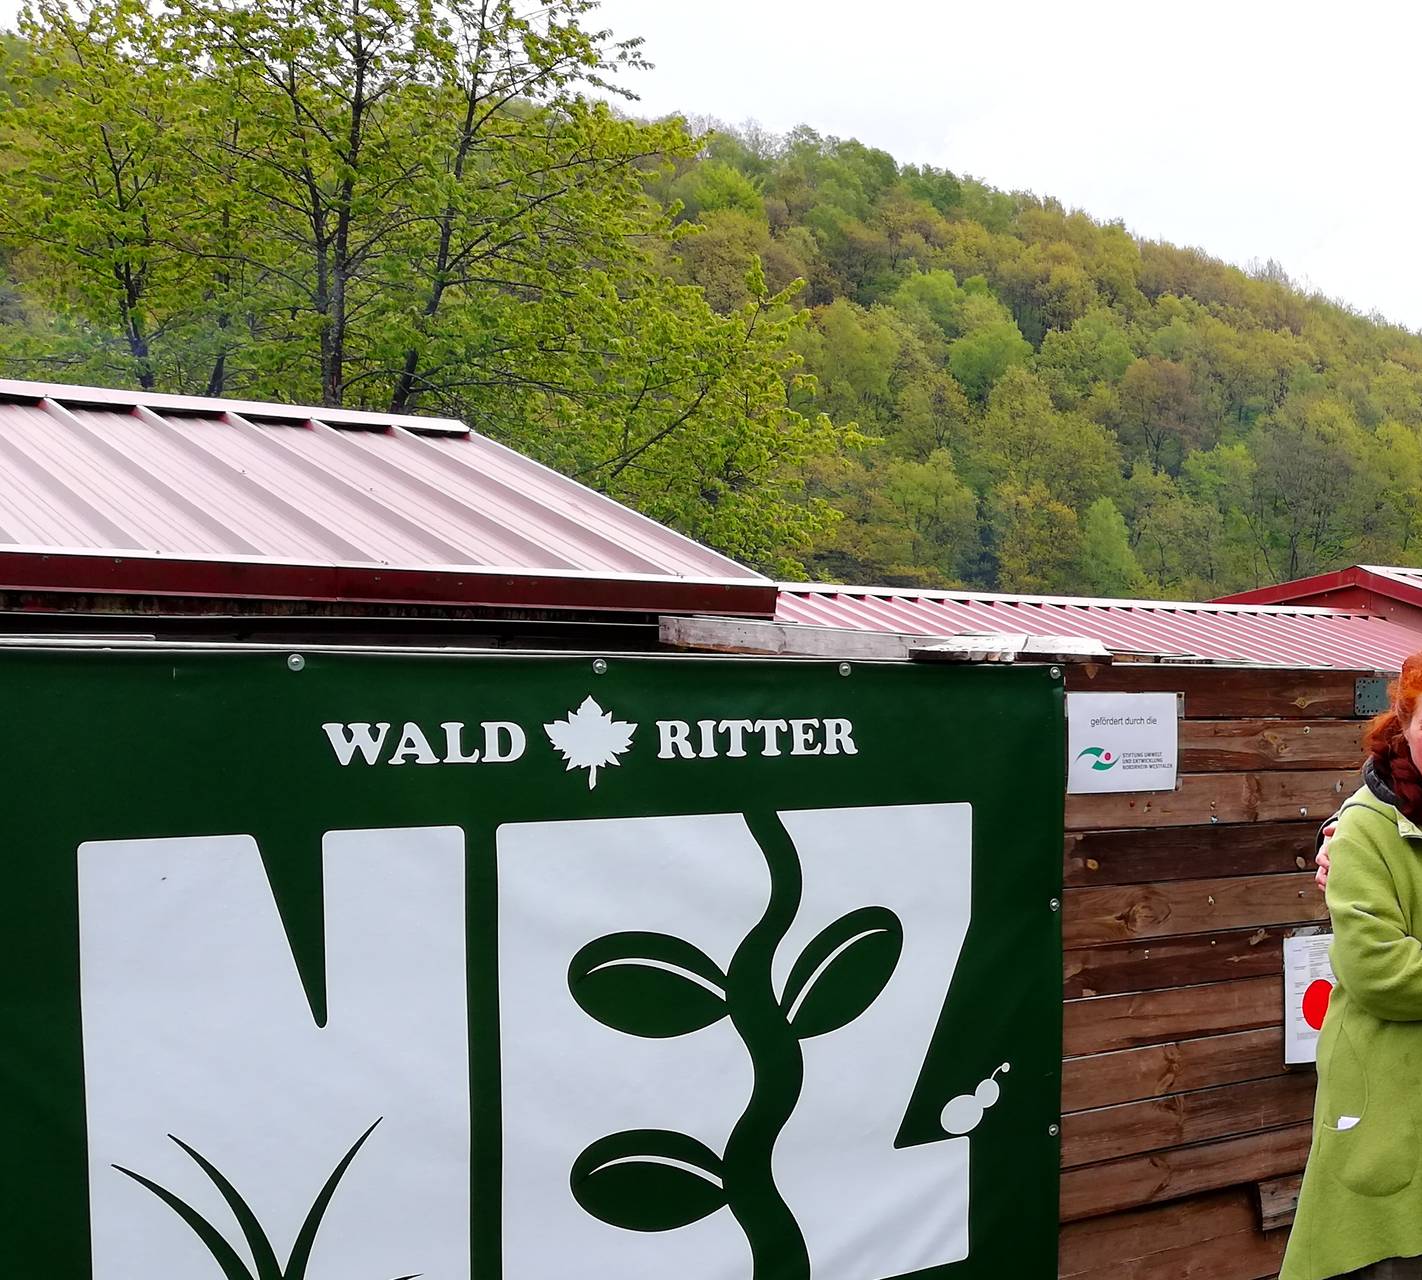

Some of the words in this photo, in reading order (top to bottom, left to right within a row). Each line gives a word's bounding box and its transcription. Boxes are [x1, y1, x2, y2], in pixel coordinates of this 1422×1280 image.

[1090, 716, 1123, 728] gefördert
[1124, 716, 1145, 726] durch
[1146, 716, 1157, 725] die
[322, 721, 527, 766] WALD
[655, 717, 859, 760] RITTER
